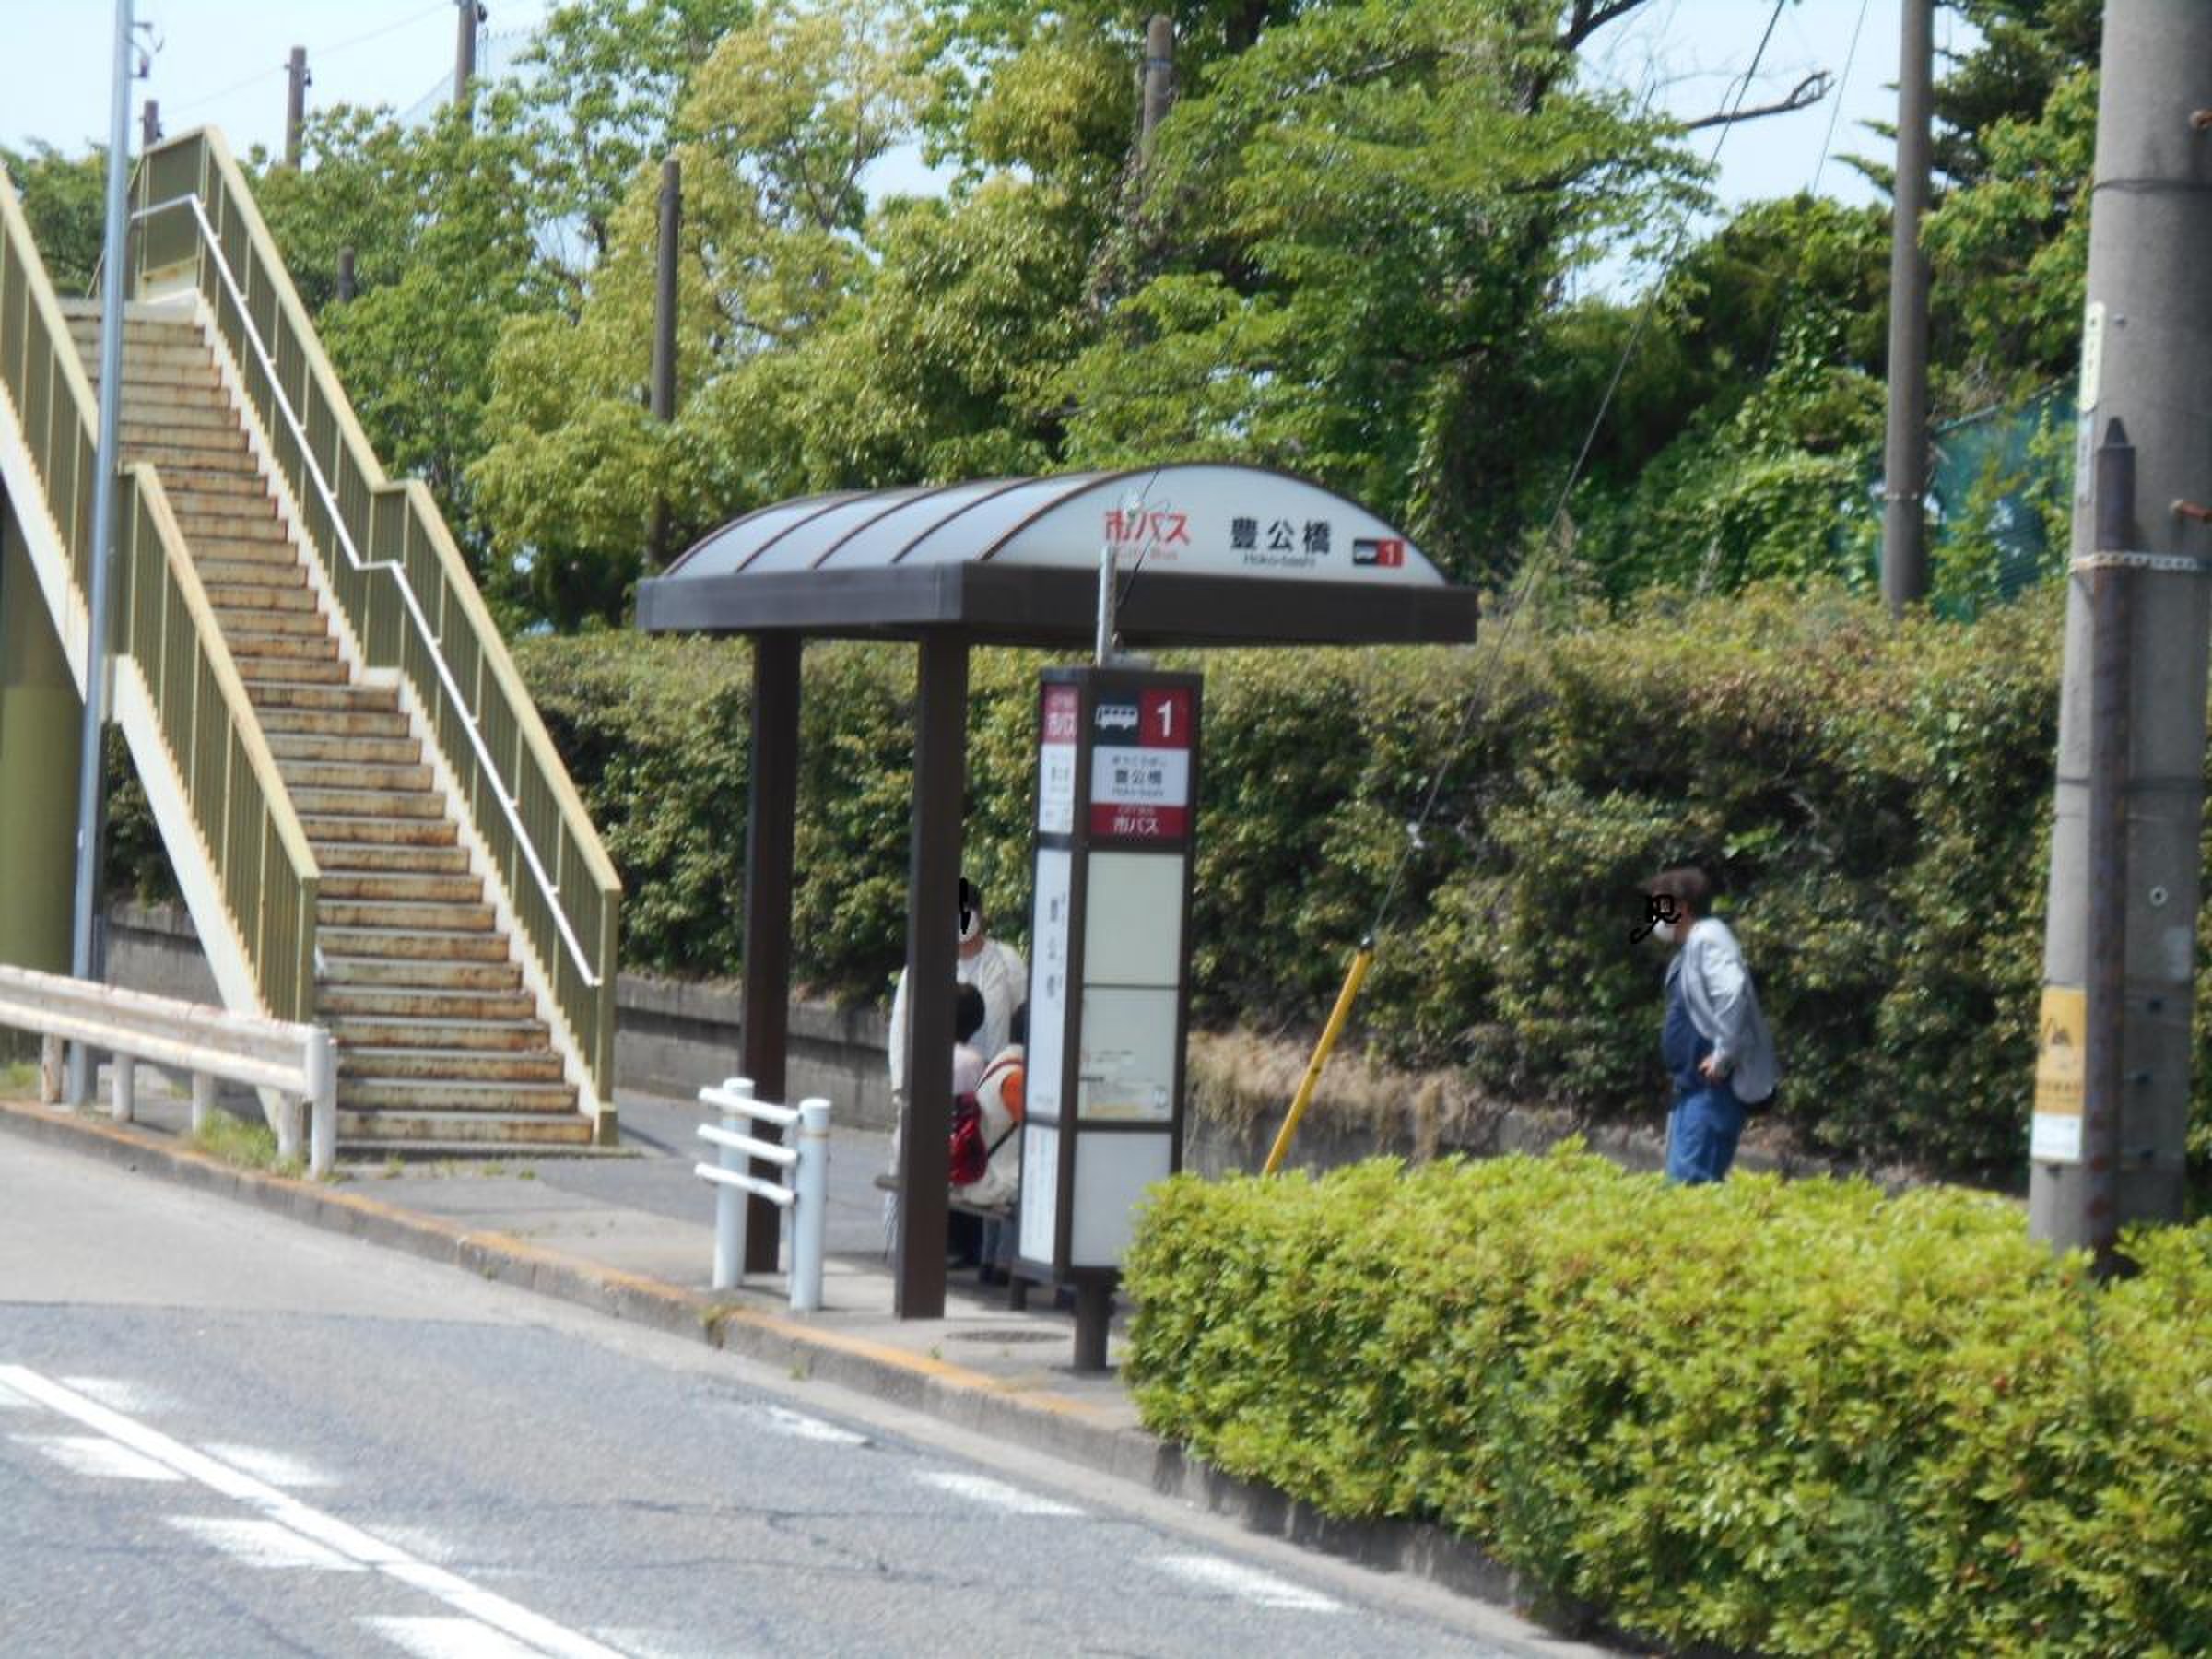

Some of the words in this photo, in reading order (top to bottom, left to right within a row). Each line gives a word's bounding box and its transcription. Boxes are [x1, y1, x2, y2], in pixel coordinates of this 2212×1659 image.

[1105, 511, 1191, 545] 市バス
[1231, 516, 1331, 555] 豊公橋
[1384, 542, 1395, 564] 1
[1156, 700, 1172, 738] 1
